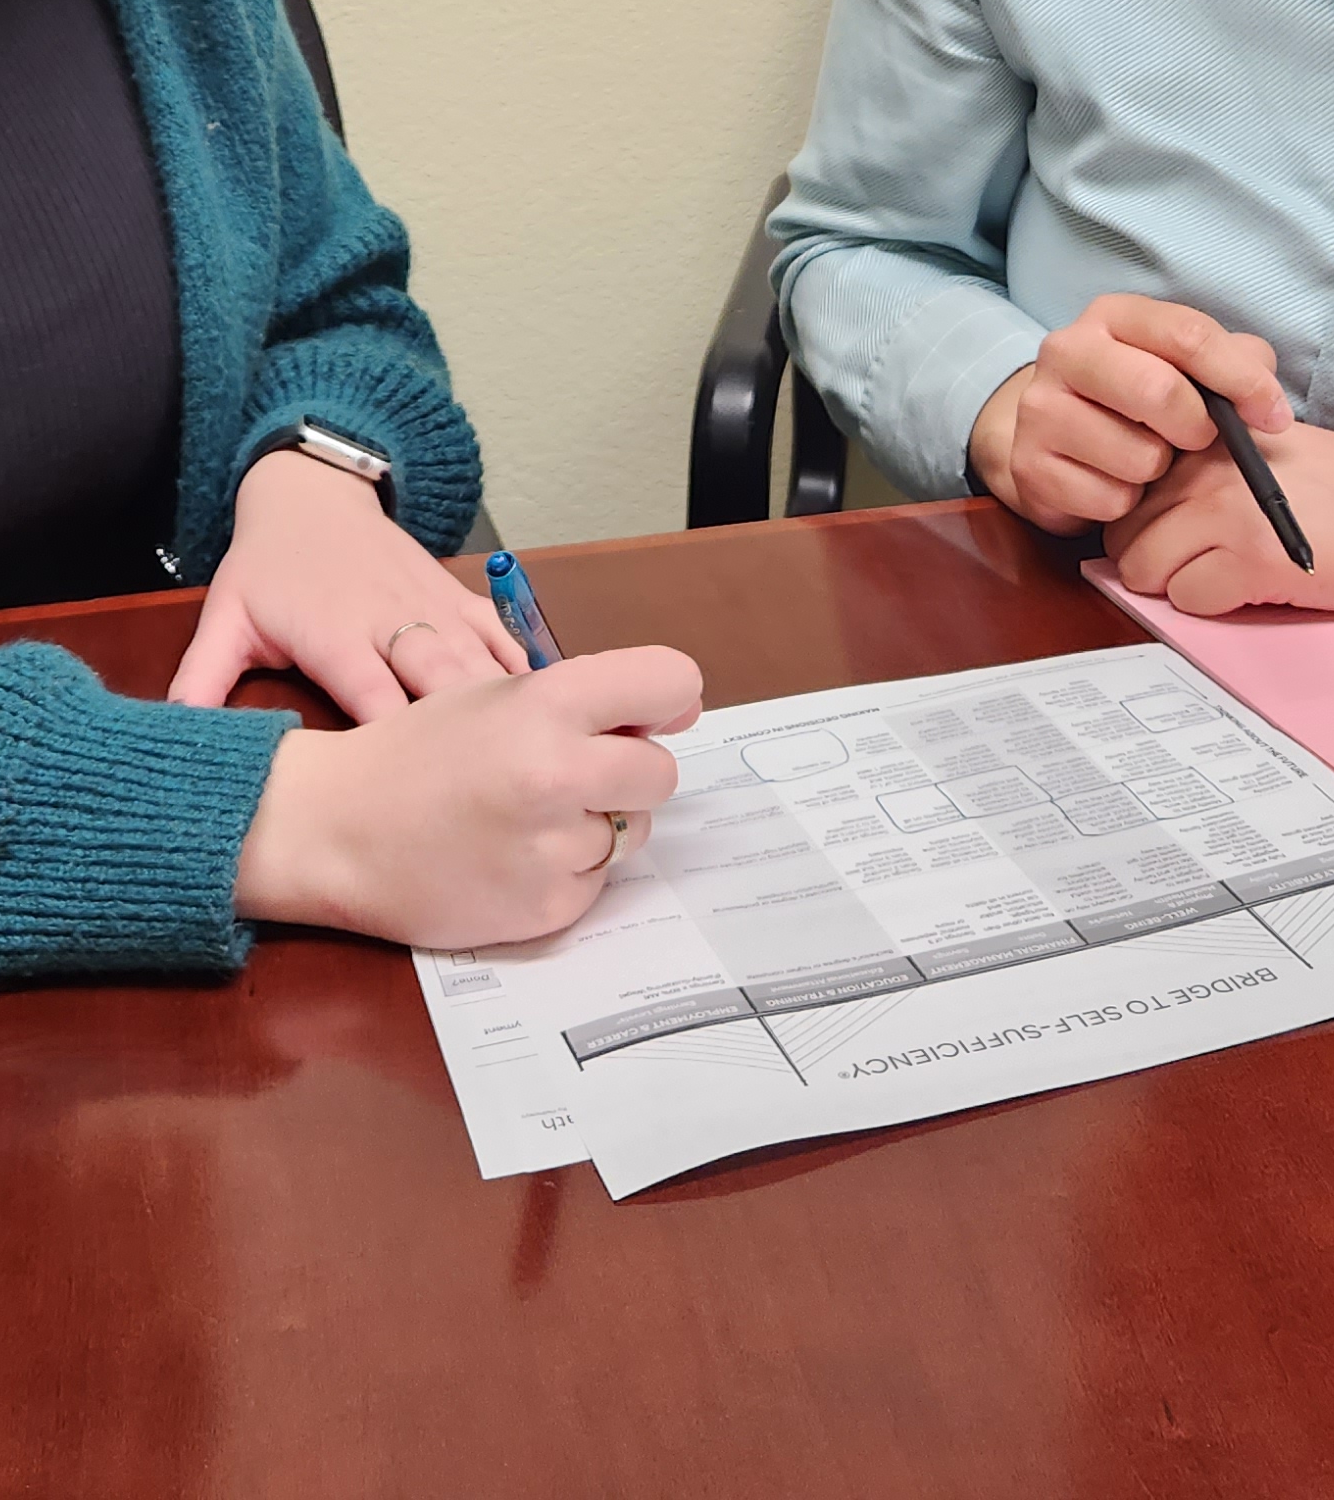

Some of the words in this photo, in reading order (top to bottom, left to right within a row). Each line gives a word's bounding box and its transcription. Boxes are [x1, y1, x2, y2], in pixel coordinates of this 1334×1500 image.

[784, 715, 838, 729] DECISIONS
[722, 729, 771, 743] CONTEXT
[1268, 872, 1323, 892] STABILITY
[1124, 907, 1197, 929] WELL-BEING
[1013, 936, 1076, 954] FINANCIAL
[930, 951, 1013, 974] MANAGEMENT
[451, 974, 489, 986] Done?
[826, 966, 883, 982] Educational
[825, 988, 836, 996] &
[837, 974, 908, 993] EDUCATION
[1168, 967, 1276, 1004] BRIDGE
[765, 991, 825, 1006] TRAINING
[1125, 995, 1170, 1014] TO
[653, 1005, 737, 1028] EMPLOYMENT
[483, 1019, 521, 1035] yment
[639, 1023, 649, 1031] &
[586, 1027, 638, 1048] CAREER
